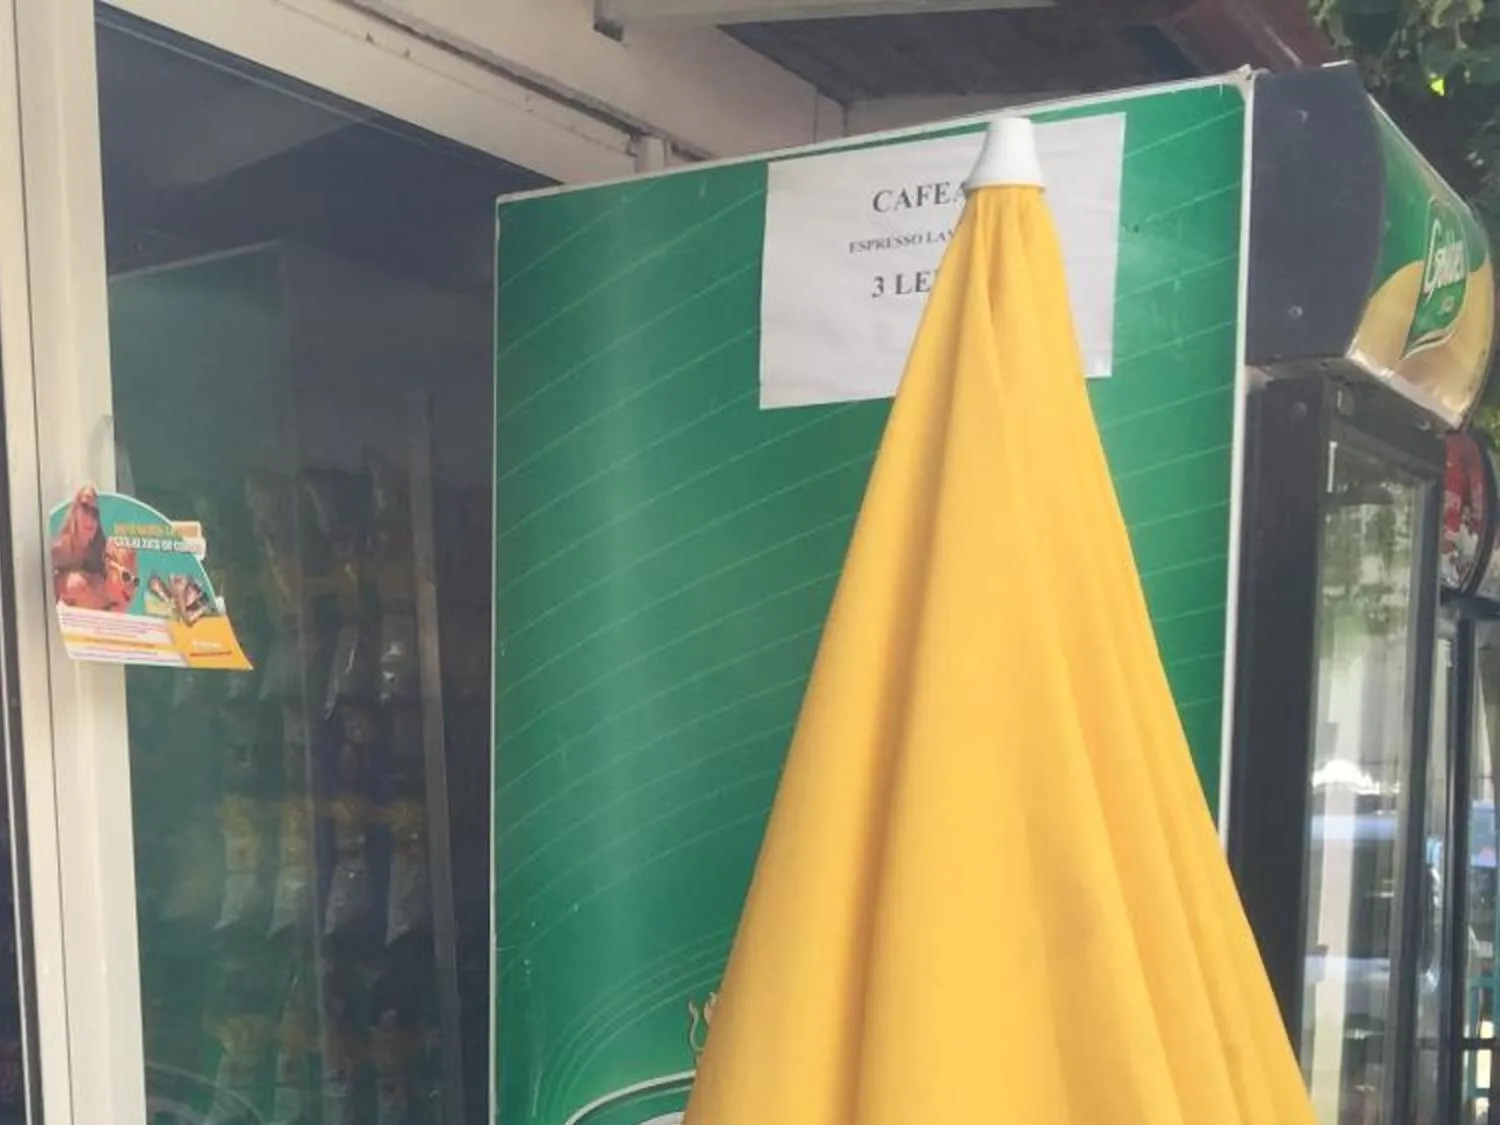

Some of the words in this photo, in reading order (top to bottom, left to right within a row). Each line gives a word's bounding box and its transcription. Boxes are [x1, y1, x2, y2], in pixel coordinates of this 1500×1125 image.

[848, 233, 924, 255] ESPRESSO
[870, 275, 885, 299] 3
[895, 268, 938, 296] LE
